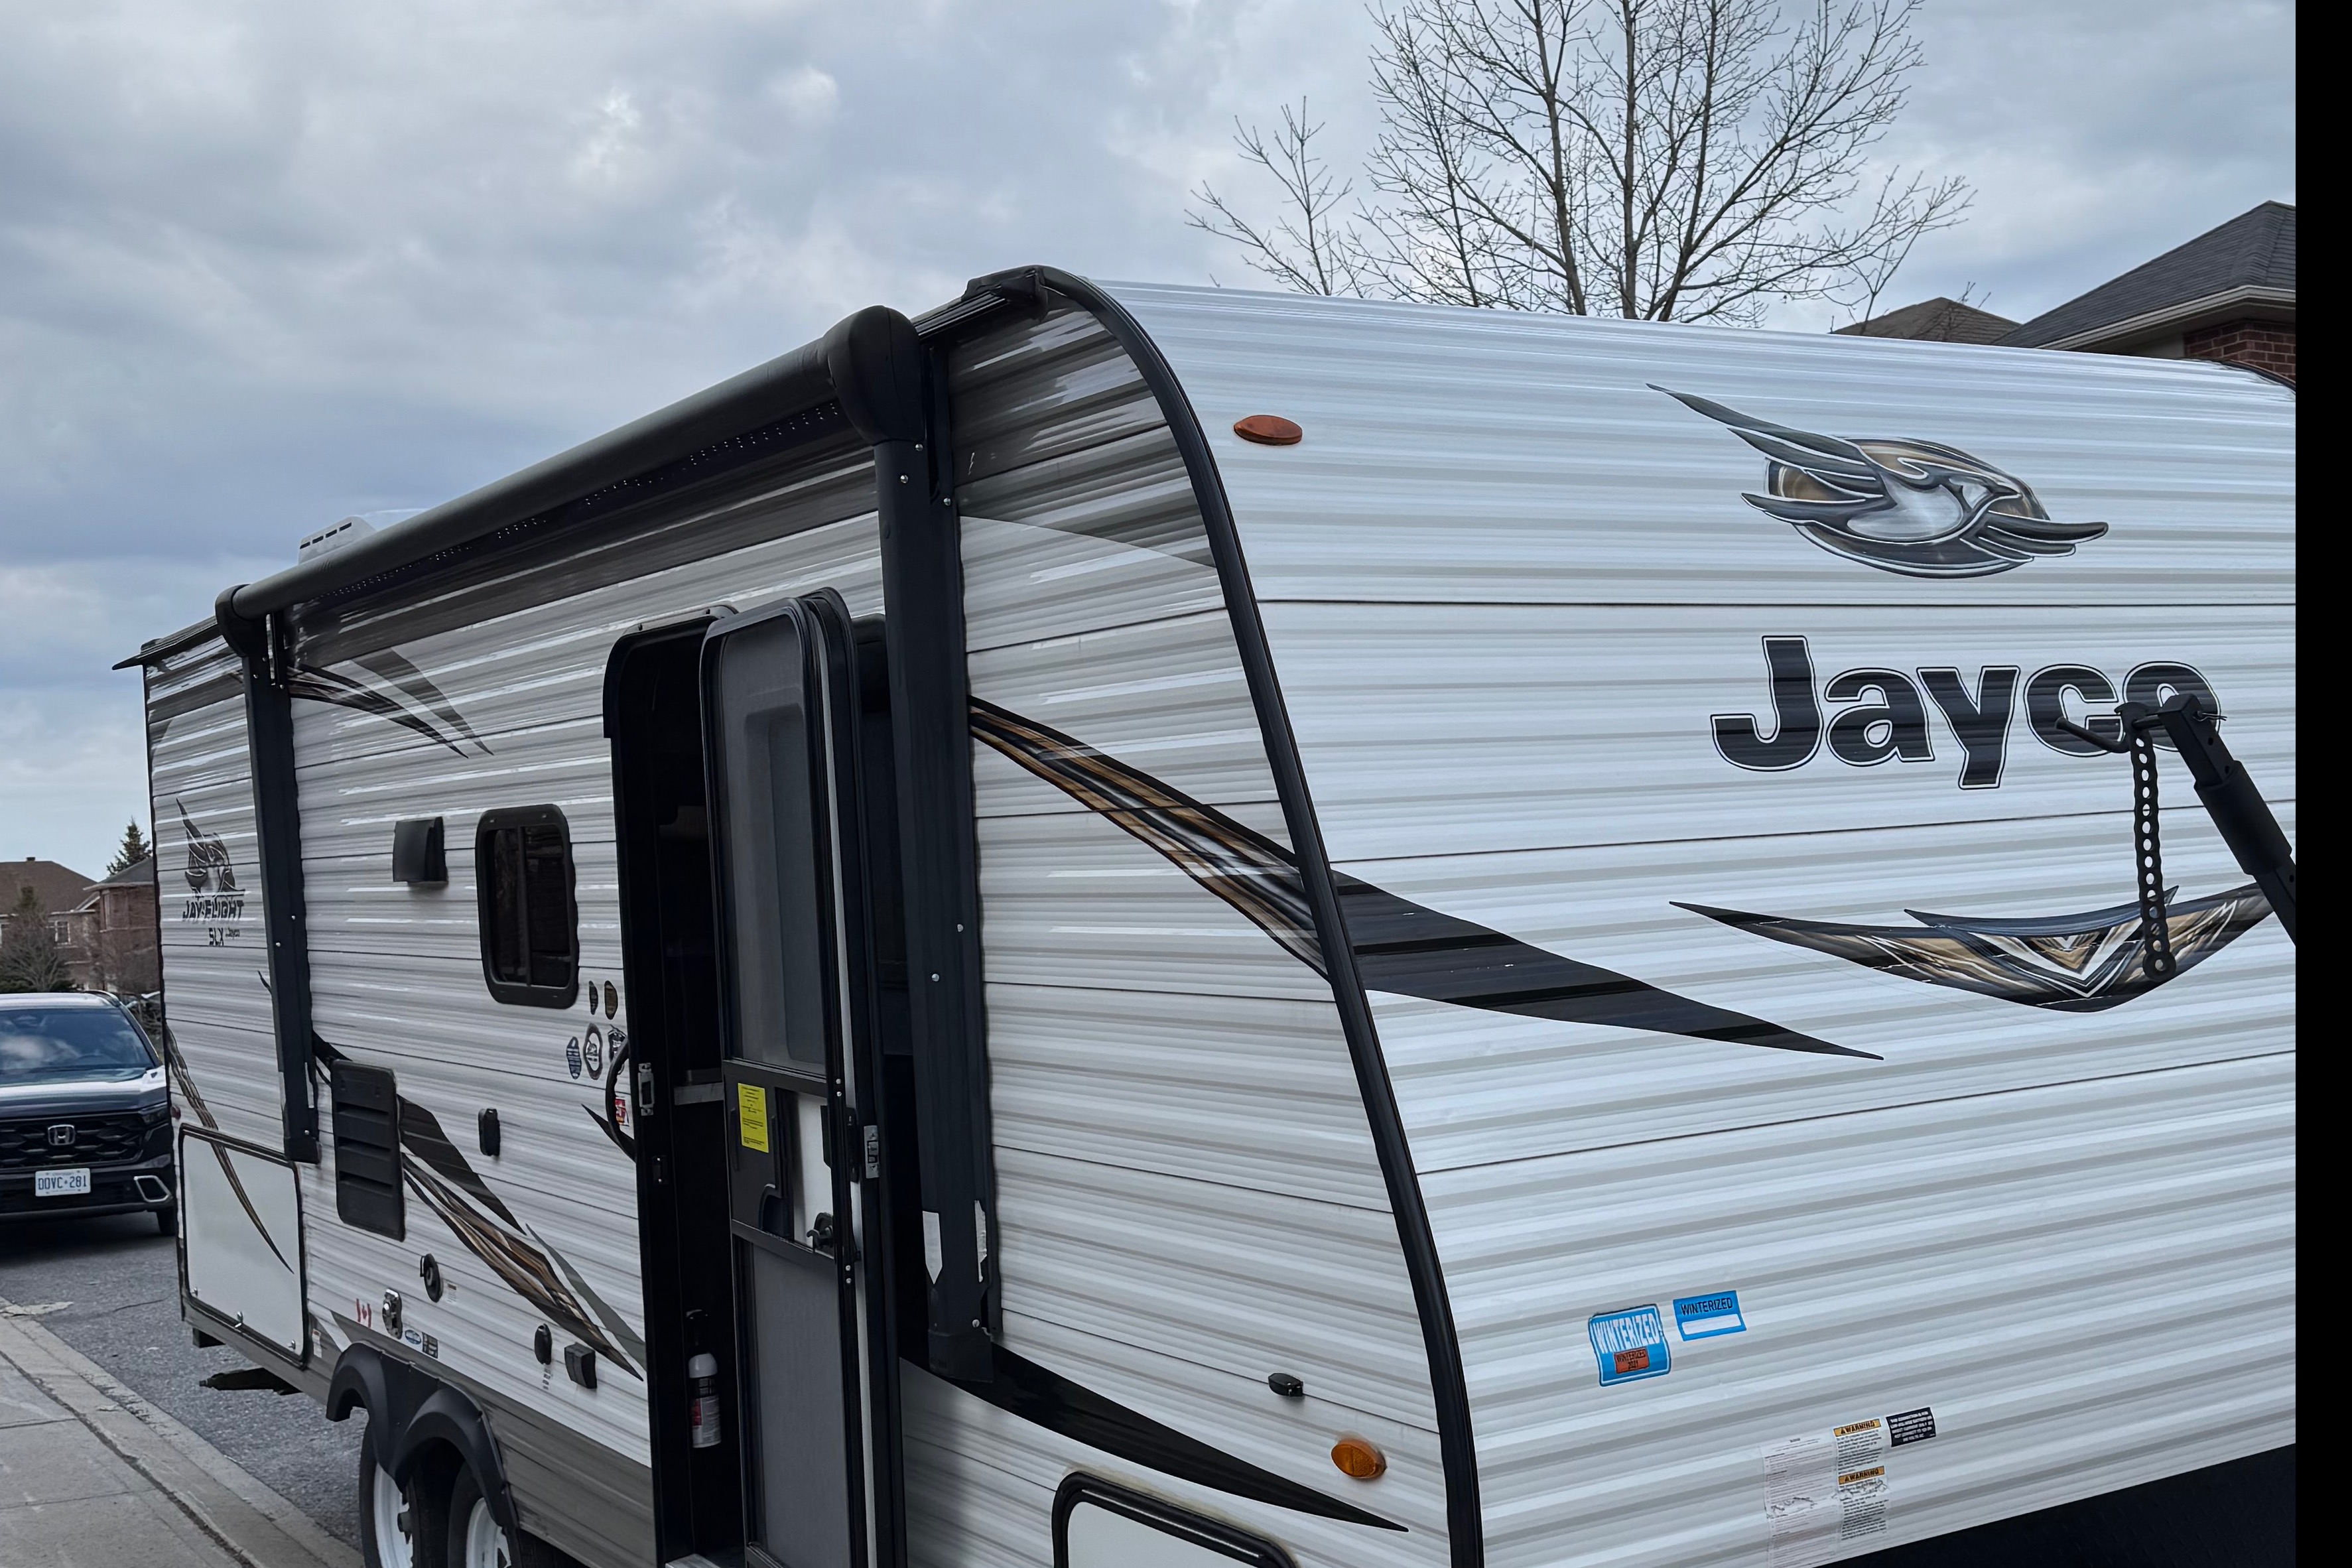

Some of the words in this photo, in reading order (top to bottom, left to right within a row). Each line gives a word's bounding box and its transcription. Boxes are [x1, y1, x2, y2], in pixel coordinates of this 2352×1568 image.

[1681, 1297, 1733, 1316] WINTERIZED
[1593, 1313, 1660, 1354] WINTERIZED
[1844, 1421, 1875, 1433] WARNING
[1849, 1468, 1880, 1480] WARNING
